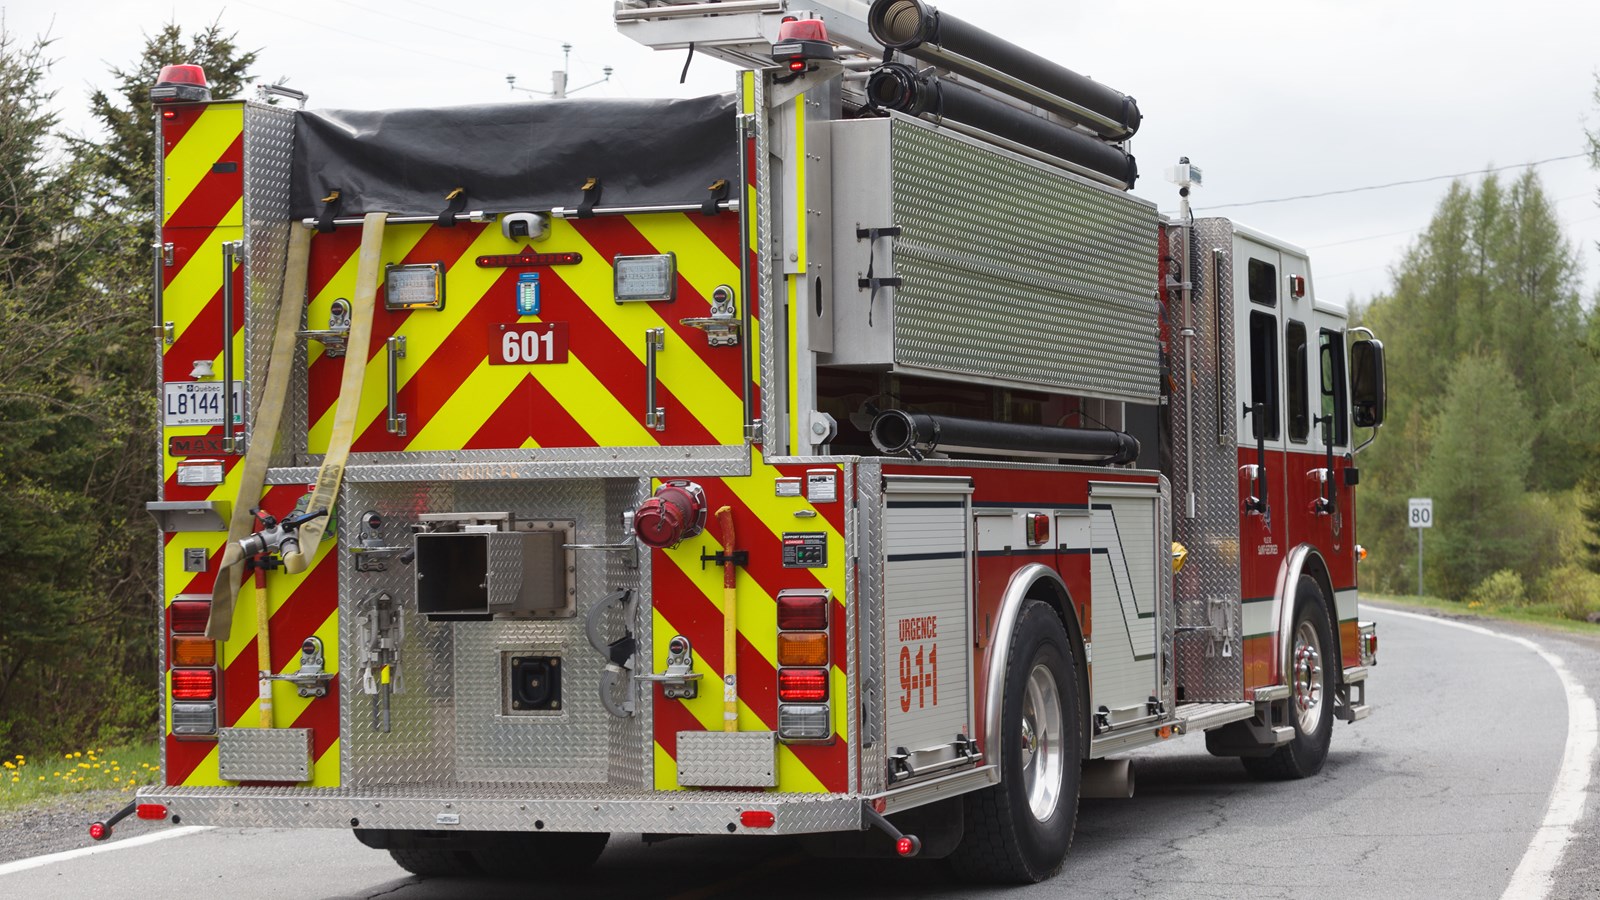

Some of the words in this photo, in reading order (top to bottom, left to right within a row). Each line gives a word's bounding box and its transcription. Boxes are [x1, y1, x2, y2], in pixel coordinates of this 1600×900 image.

[502, 331, 554, 362] 601
[168, 392, 238, 415] L81441
[175, 440, 220, 451] MAX
[1412, 508, 1430, 523] 80
[899, 616, 937, 642] URGENCE
[900, 643, 937, 712] 9-1-1
